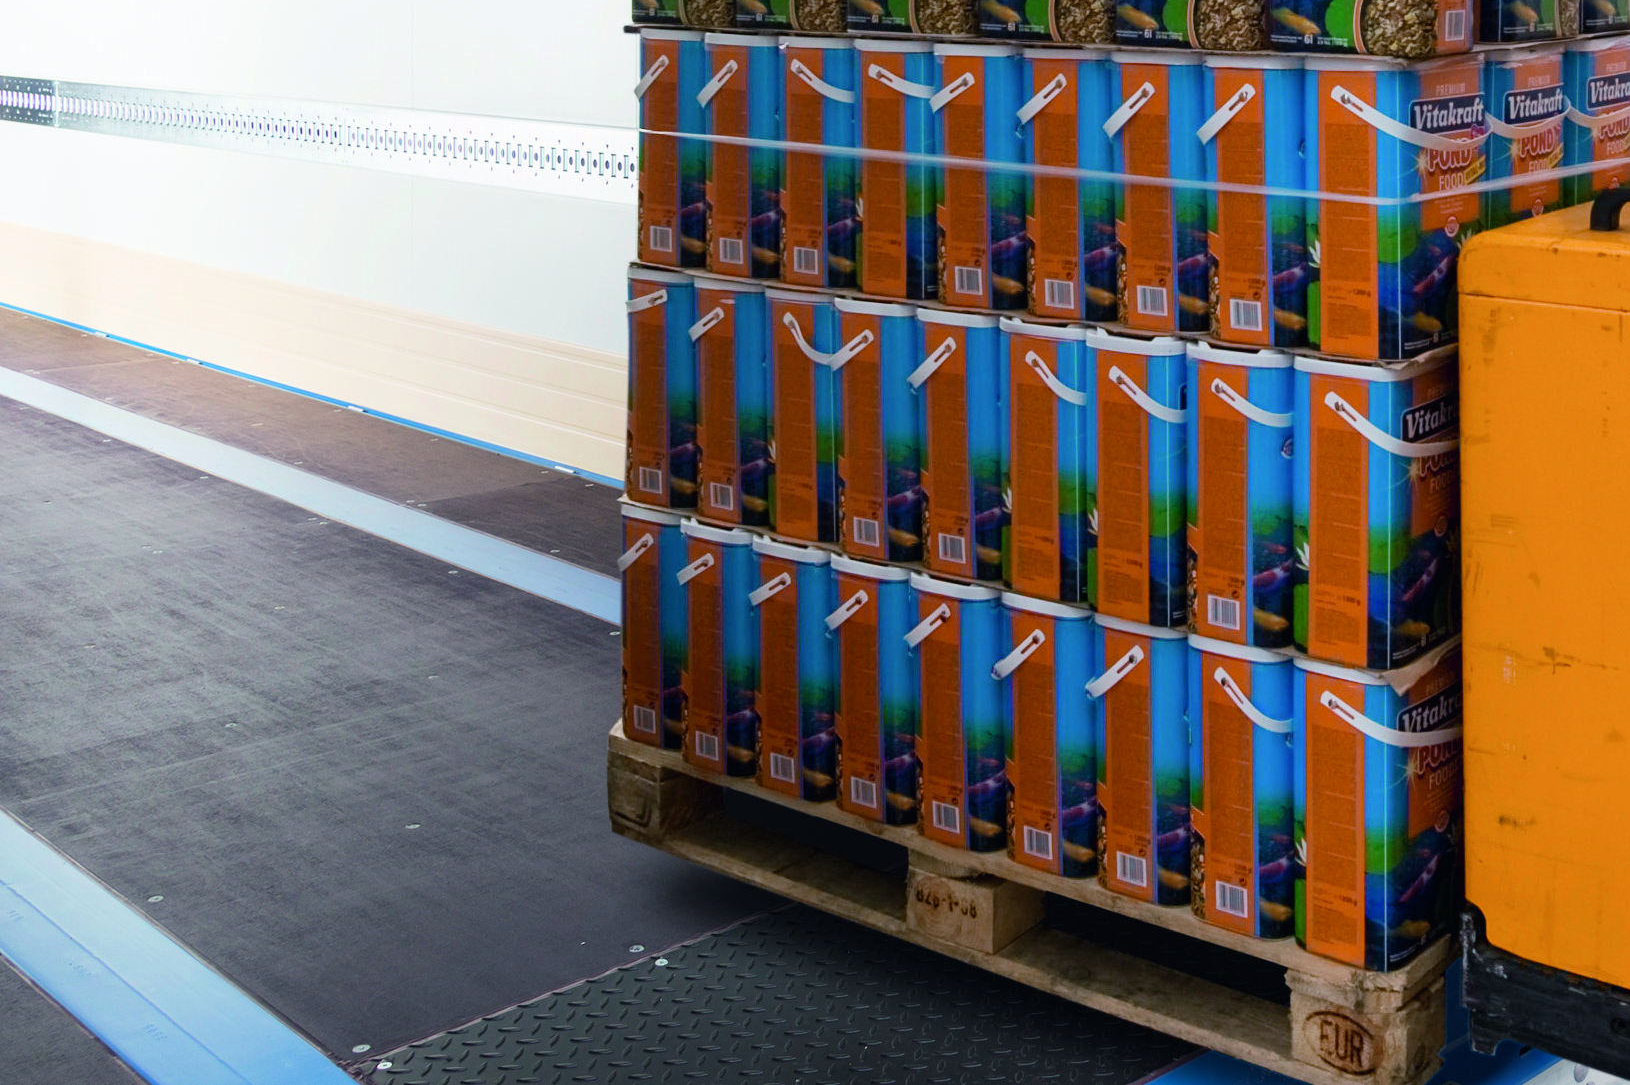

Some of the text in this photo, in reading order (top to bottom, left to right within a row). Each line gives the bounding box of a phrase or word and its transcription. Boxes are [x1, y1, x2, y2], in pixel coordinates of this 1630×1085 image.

[1436, 83, 1466, 96] PREMIUM
[1508, 89, 1563, 119] Vitakraft
[1414, 98, 1484, 130] Vitakraft
[1520, 128, 1554, 158] POND
[1428, 146, 1472, 172] POND
[1439, 173, 1464, 192] FOOD
[1319, 1019, 1364, 1069] EUR
